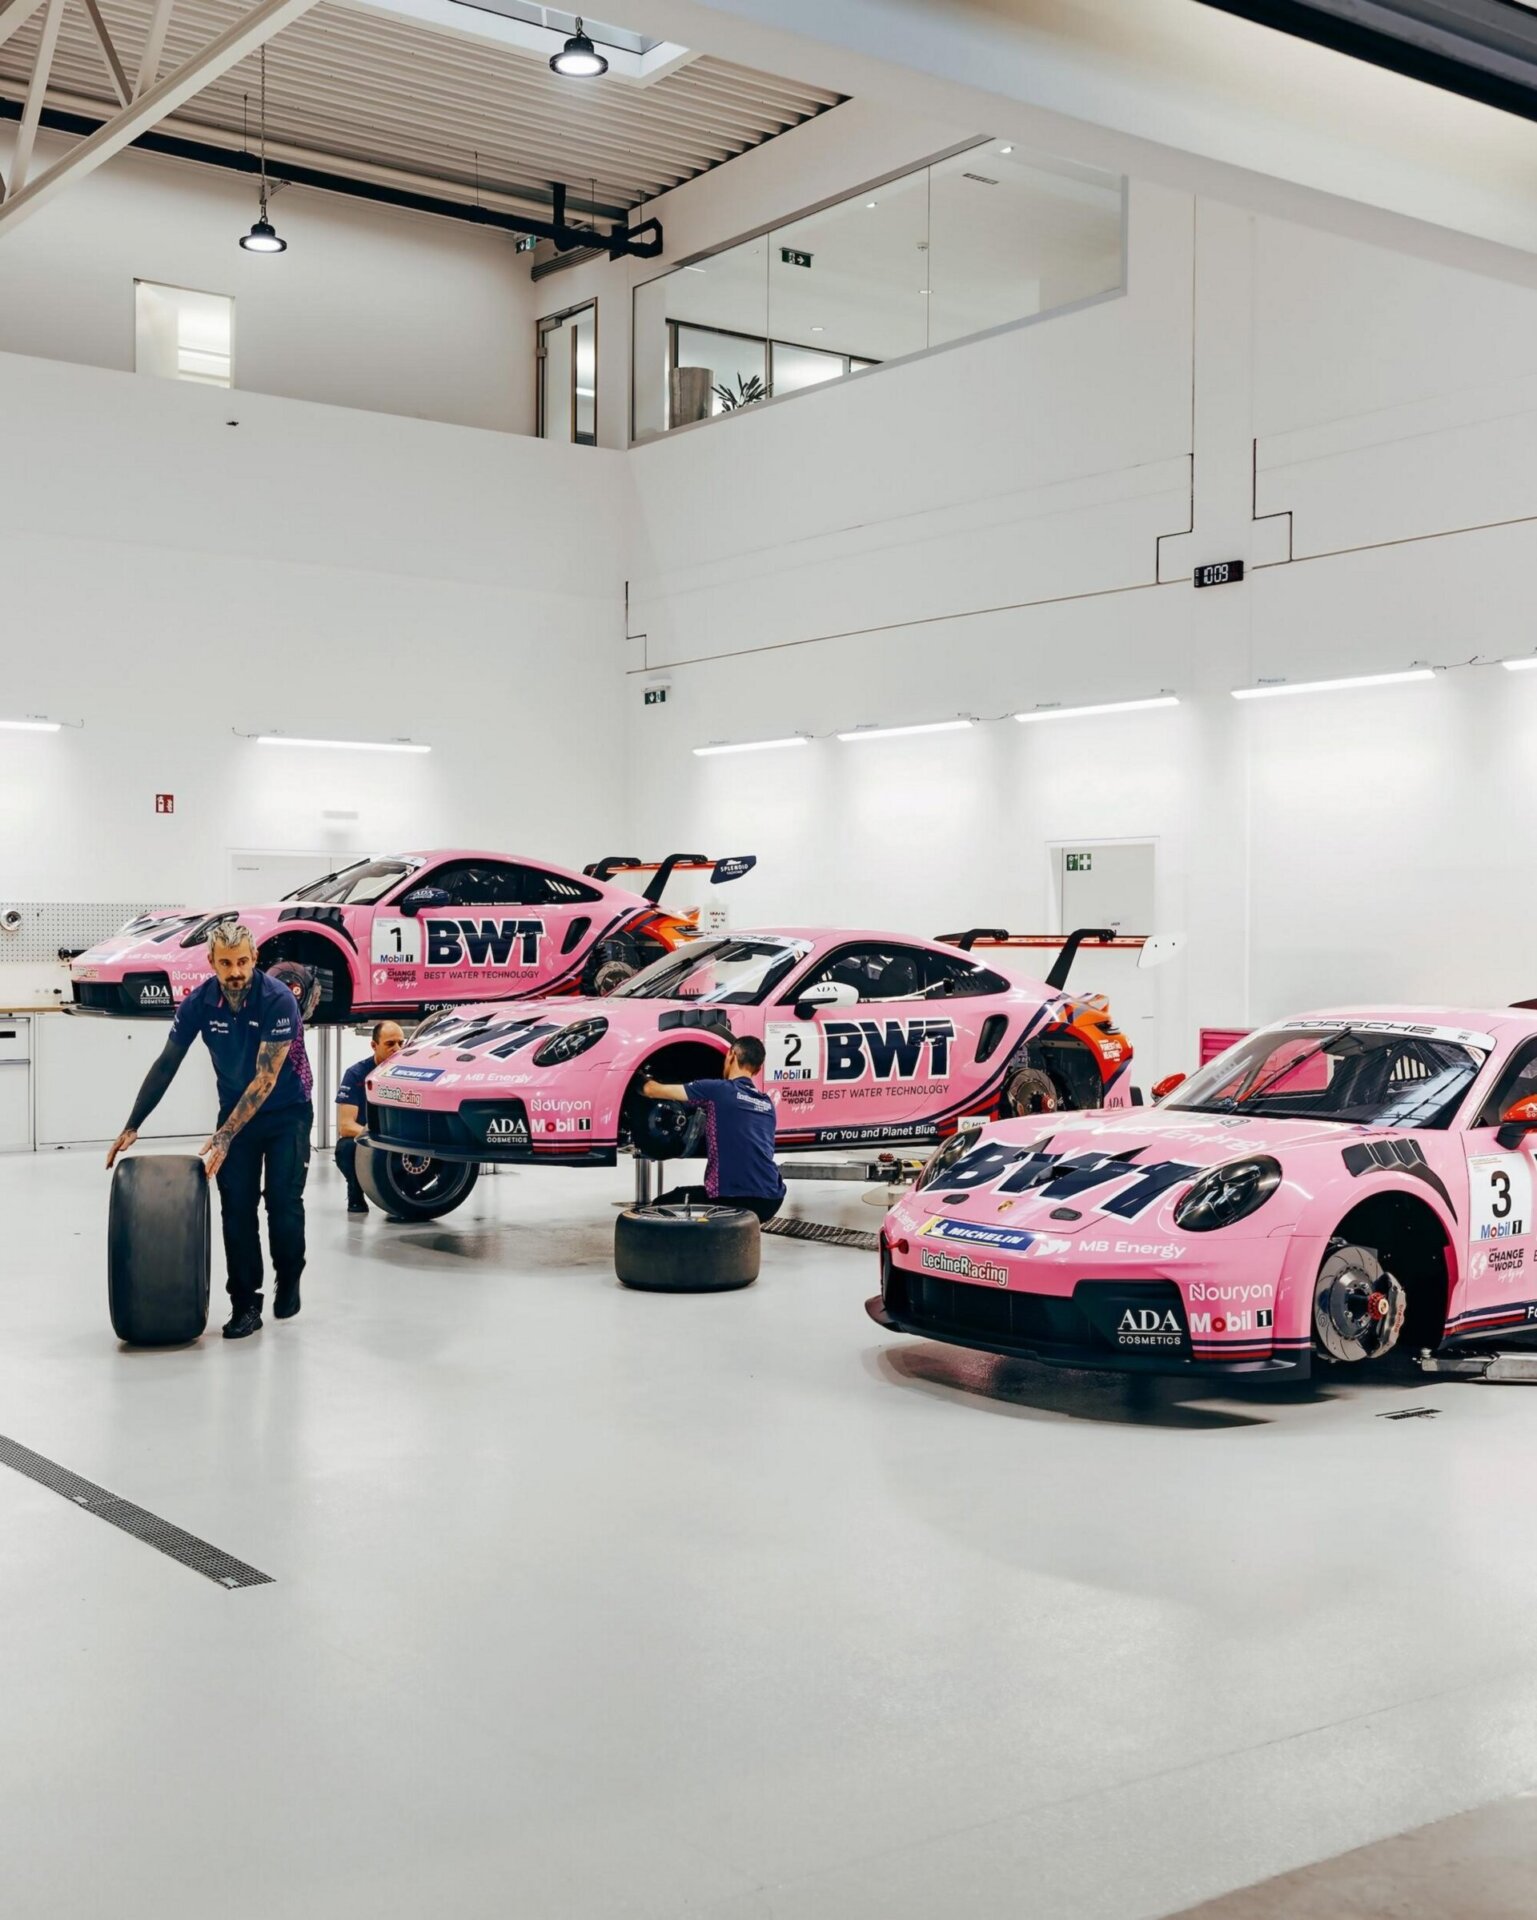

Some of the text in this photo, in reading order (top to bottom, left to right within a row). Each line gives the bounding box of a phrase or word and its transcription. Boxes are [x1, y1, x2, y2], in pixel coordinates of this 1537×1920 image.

[390, 927, 402, 953] 1
[424, 917, 547, 968] BWT
[380, 954, 413, 963] Mobil 1
[424, 971, 540, 980] BEST WATER TECHNOLOGY
[140, 985, 170, 997] ADA
[1283, 1021, 1437, 1035] PORSCHE
[784, 1033, 802, 1067] 2
[821, 1017, 957, 1085] BWT
[393, 1069, 436, 1079] MICHELIN
[464, 1073, 532, 1084] MB Energy
[774, 1069, 812, 1080] Mobil 1
[782, 1089, 814, 1098] CHANGE
[822, 1084, 950, 1100] BEST WATER TECHNOLOGY
[531, 1099, 592, 1112] Nouryon
[787, 1097, 814, 1105] WORLD
[486, 1119, 528, 1134] ADA
[531, 1118, 590, 1132] Mobil 1
[820, 1124, 938, 1141] For You and Planet Blue.
[913, 1138, 1208, 1225] BWT
[1491, 1171, 1512, 1218] 3
[948, 1227, 1025, 1245] MICHELIN
[1480, 1220, 1522, 1239] Mobil 1
[1078, 1241, 1187, 1258] MB Energy
[1488, 1248, 1524, 1262] CHANGE
[1494, 1259, 1523, 1271] WORLD
[1189, 1283, 1273, 1303] Nouryon
[1117, 1309, 1182, 1331] ADA
[1191, 1308, 1273, 1333] Mobil 1
[1118, 1335, 1182, 1345] COSMETICS
